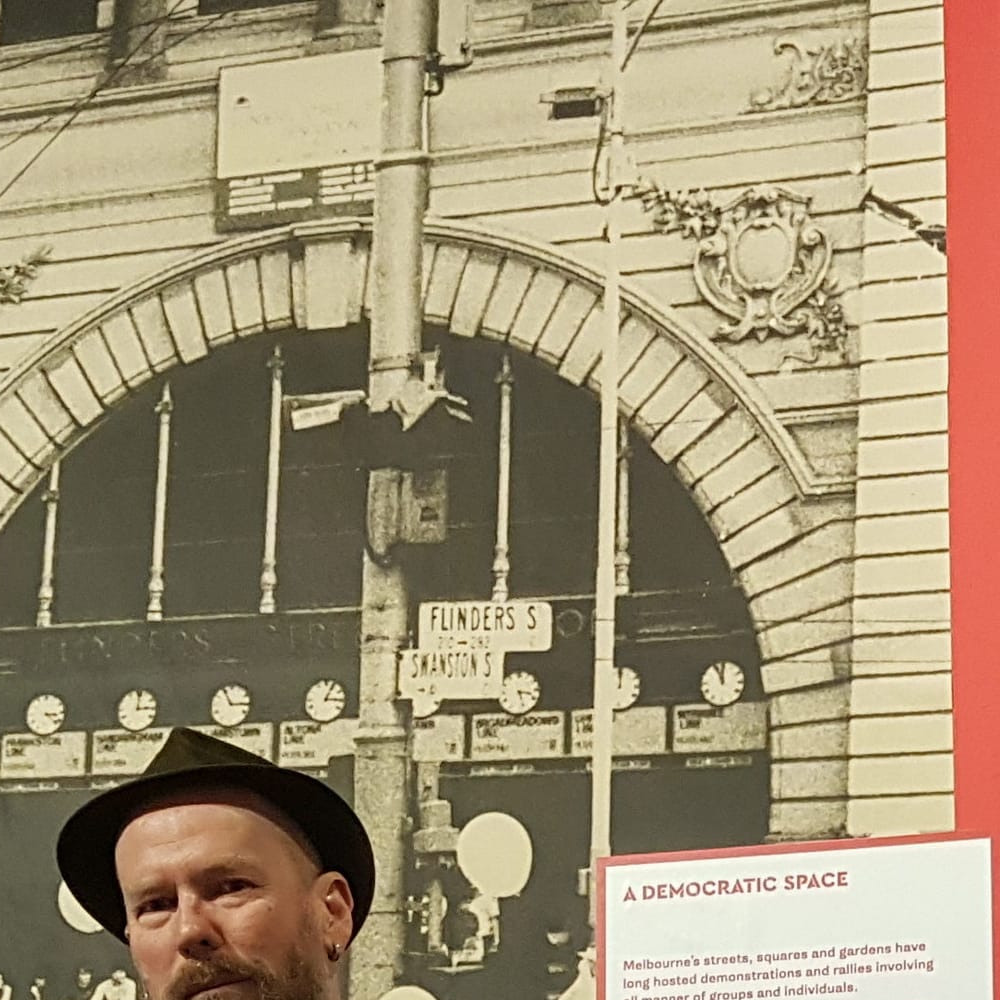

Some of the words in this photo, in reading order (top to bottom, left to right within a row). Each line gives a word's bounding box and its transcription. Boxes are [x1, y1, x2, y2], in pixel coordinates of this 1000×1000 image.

[431, 606, 515, 631] FLINDERS
[412, 652, 477, 678] SWANSTON
[623, 886, 636, 901] A
[642, 877, 778, 900] DEMOCRATIC
[784, 872, 847, 891] SPACE
[623, 954, 700, 970] Melbourne's
[703, 952, 752, 965] streets,
[756, 950, 807, 965] squares
[811, 945, 835, 959] and
[839, 943, 891, 960] gardens
[895, 941, 925, 953] have
[623, 977, 650, 991] long
[653, 972, 697, 987] hosted
[700, 967, 802, 984] demonstrations
[805, 964, 829, 977] and
[833, 962, 872, 976] rallies
[875, 958, 933, 973] involving
[756, 985, 780, 998] and
[784, 981, 857, 997] individuals.
